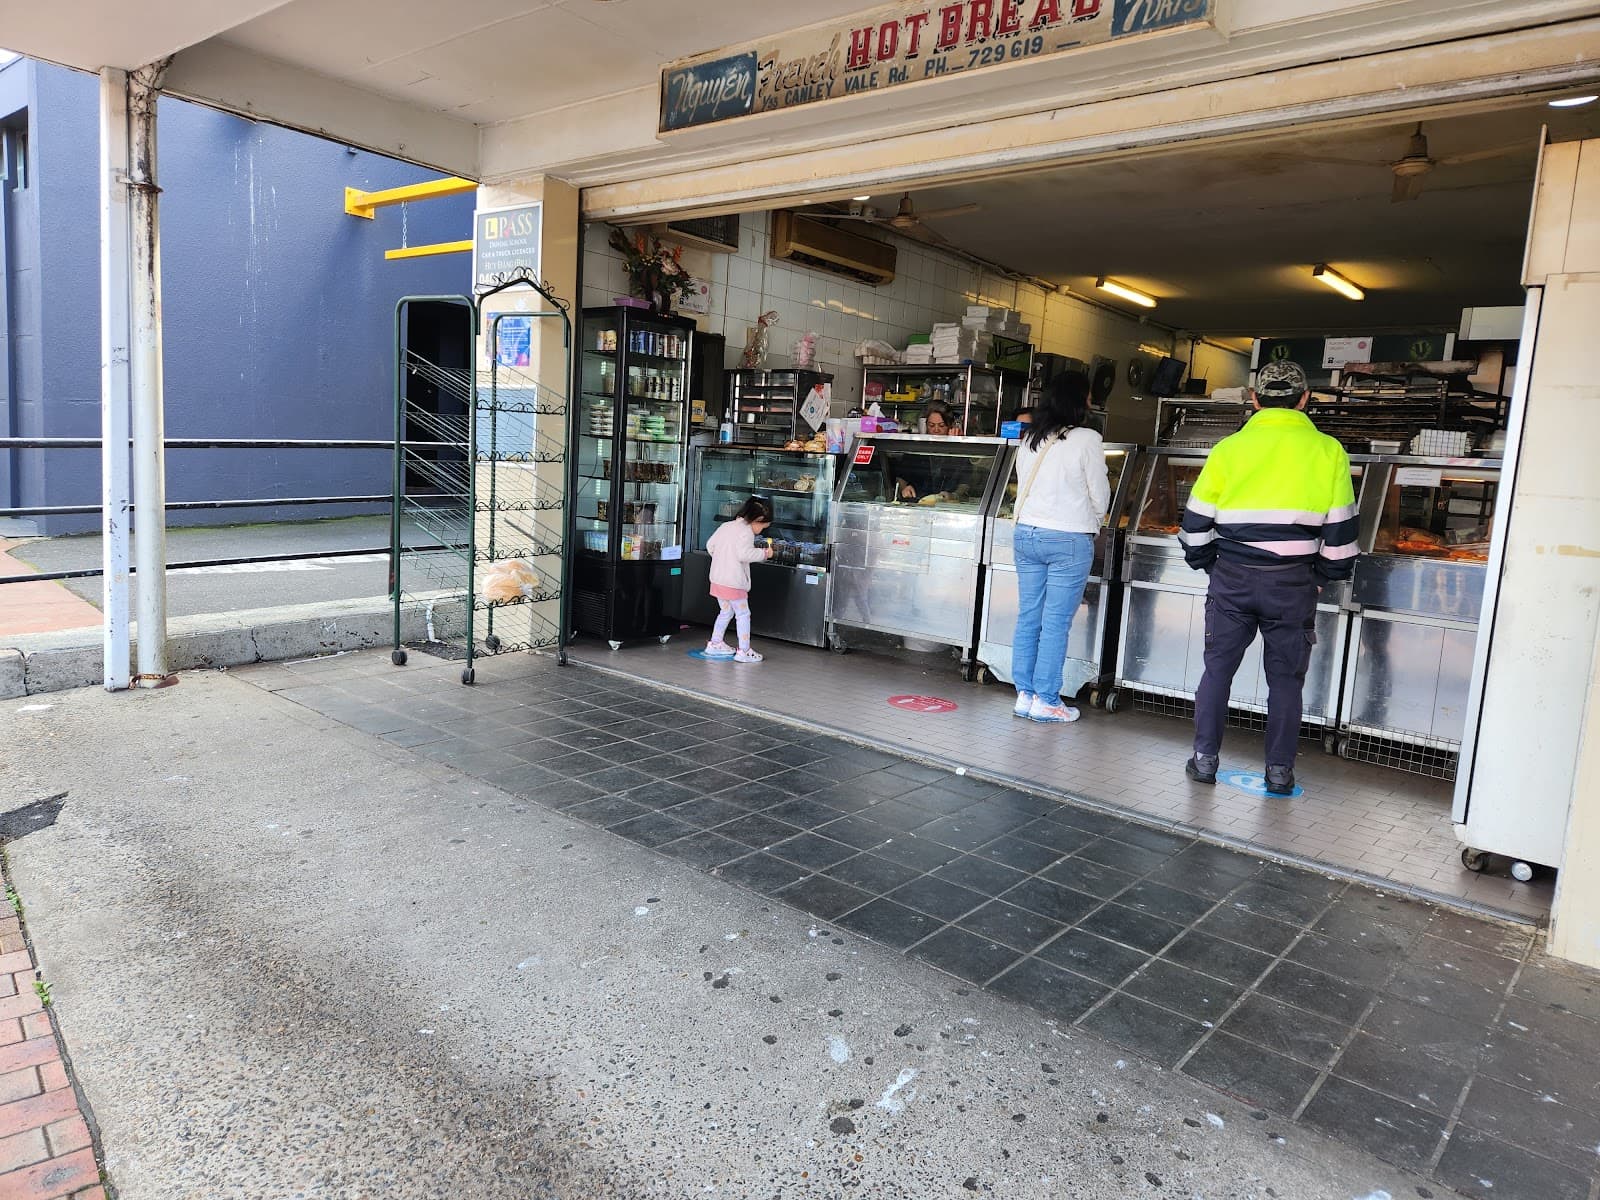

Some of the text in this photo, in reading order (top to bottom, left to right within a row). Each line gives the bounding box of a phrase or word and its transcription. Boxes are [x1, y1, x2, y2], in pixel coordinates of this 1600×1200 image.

[847, 12, 929, 70] HOT
[784, 80, 835, 106] CANLEY
[844, 71, 880, 92] VALE
[967, 43, 1005, 69] 729
[1010, 35, 1044, 59] 619
[499, 212, 533, 238] PASS
